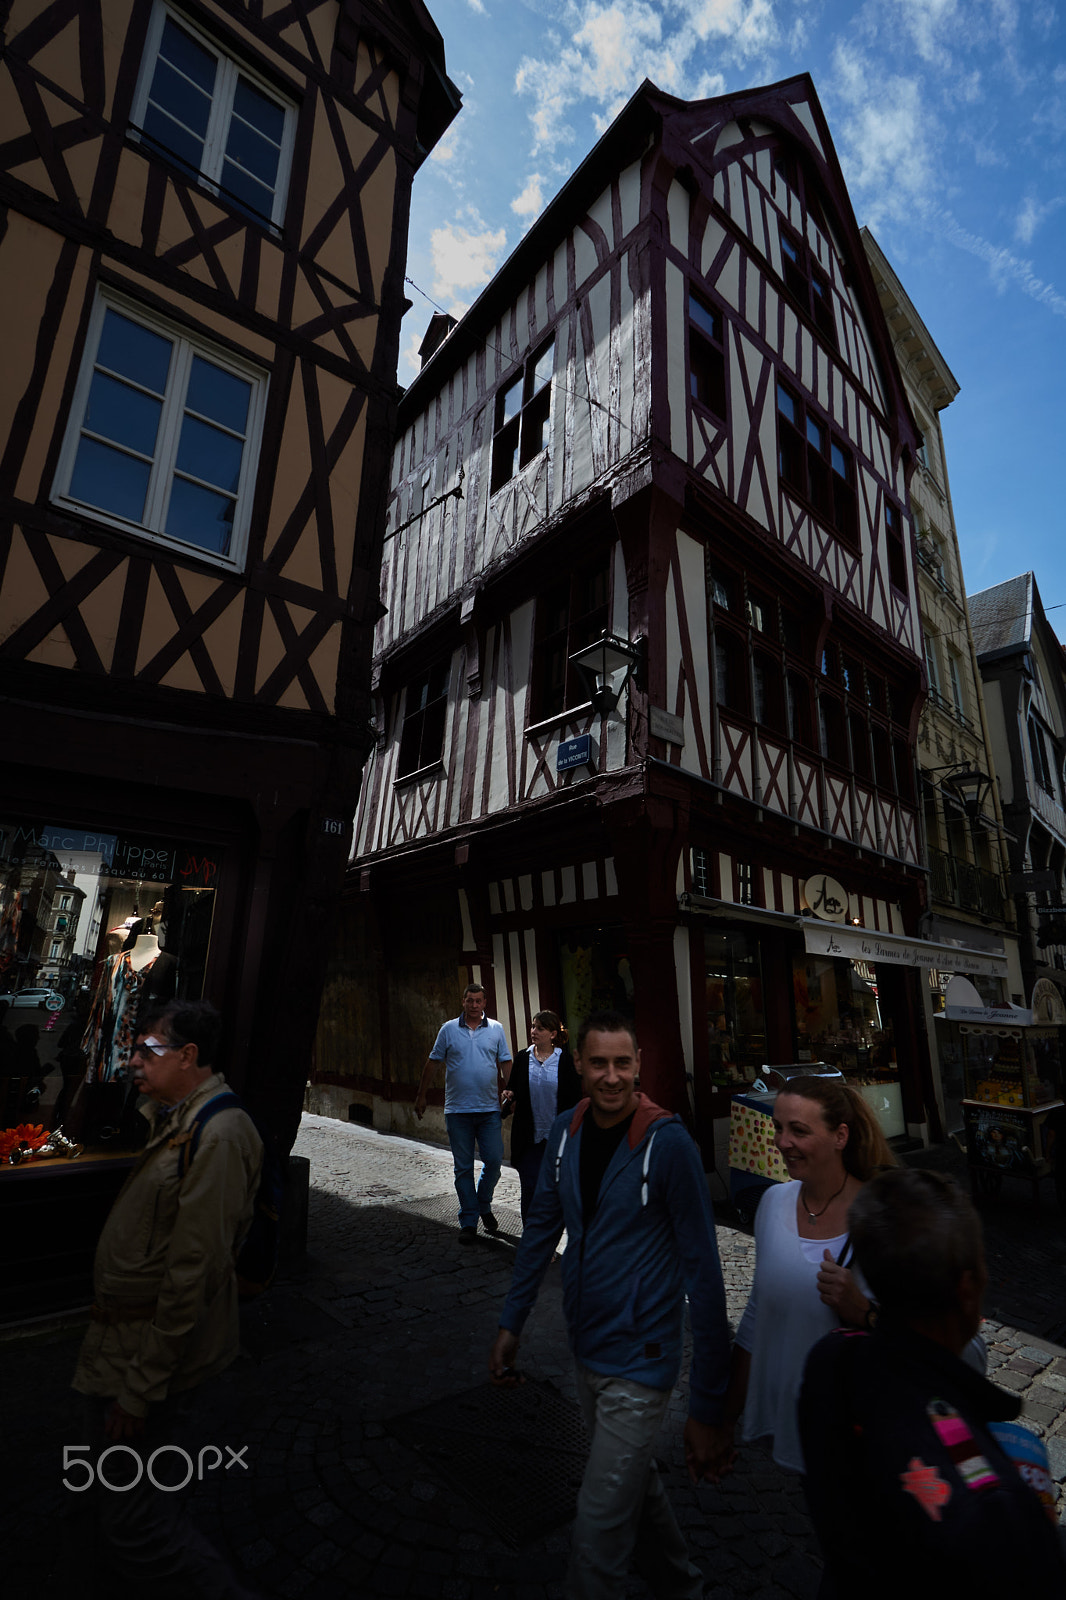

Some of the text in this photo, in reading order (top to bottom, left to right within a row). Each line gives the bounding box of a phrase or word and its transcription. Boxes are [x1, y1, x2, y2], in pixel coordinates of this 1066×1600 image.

[324, 820, 342, 835] 161
[13, 826, 75, 850] Marc
[83, 834, 169, 867] Philippe
[34, 857, 87, 872] femmes
[152, 872, 165, 881] 60
[144, 860, 168, 870] Paris
[911, 949, 934, 965] Jeanne
[987, 1010, 1018, 1020] Jeanne
